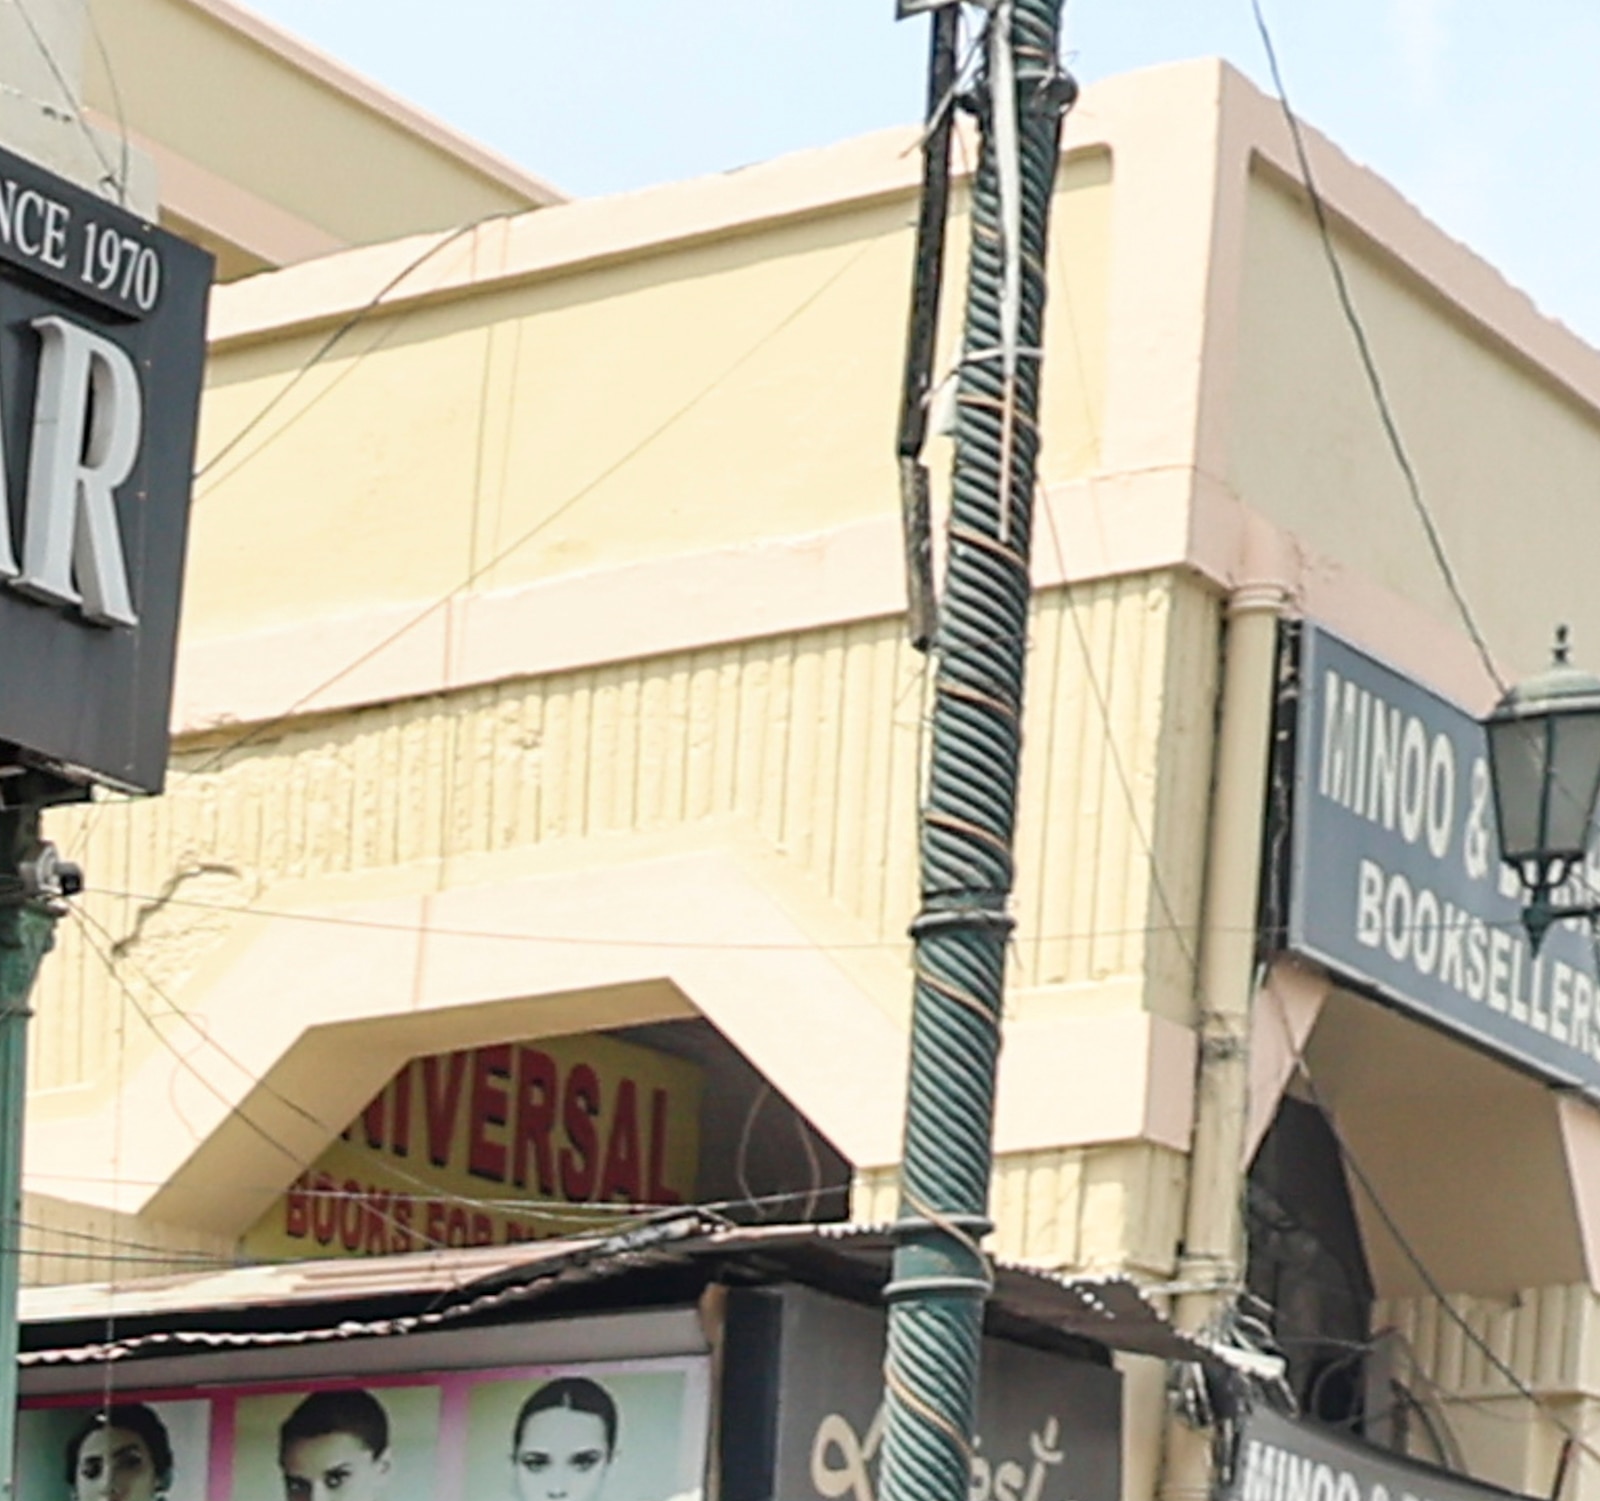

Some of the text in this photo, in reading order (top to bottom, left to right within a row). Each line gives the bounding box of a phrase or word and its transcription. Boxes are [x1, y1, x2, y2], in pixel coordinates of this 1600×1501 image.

[80, 221, 160, 311] 1970
[1319, 669, 1494, 880] MINOO &
